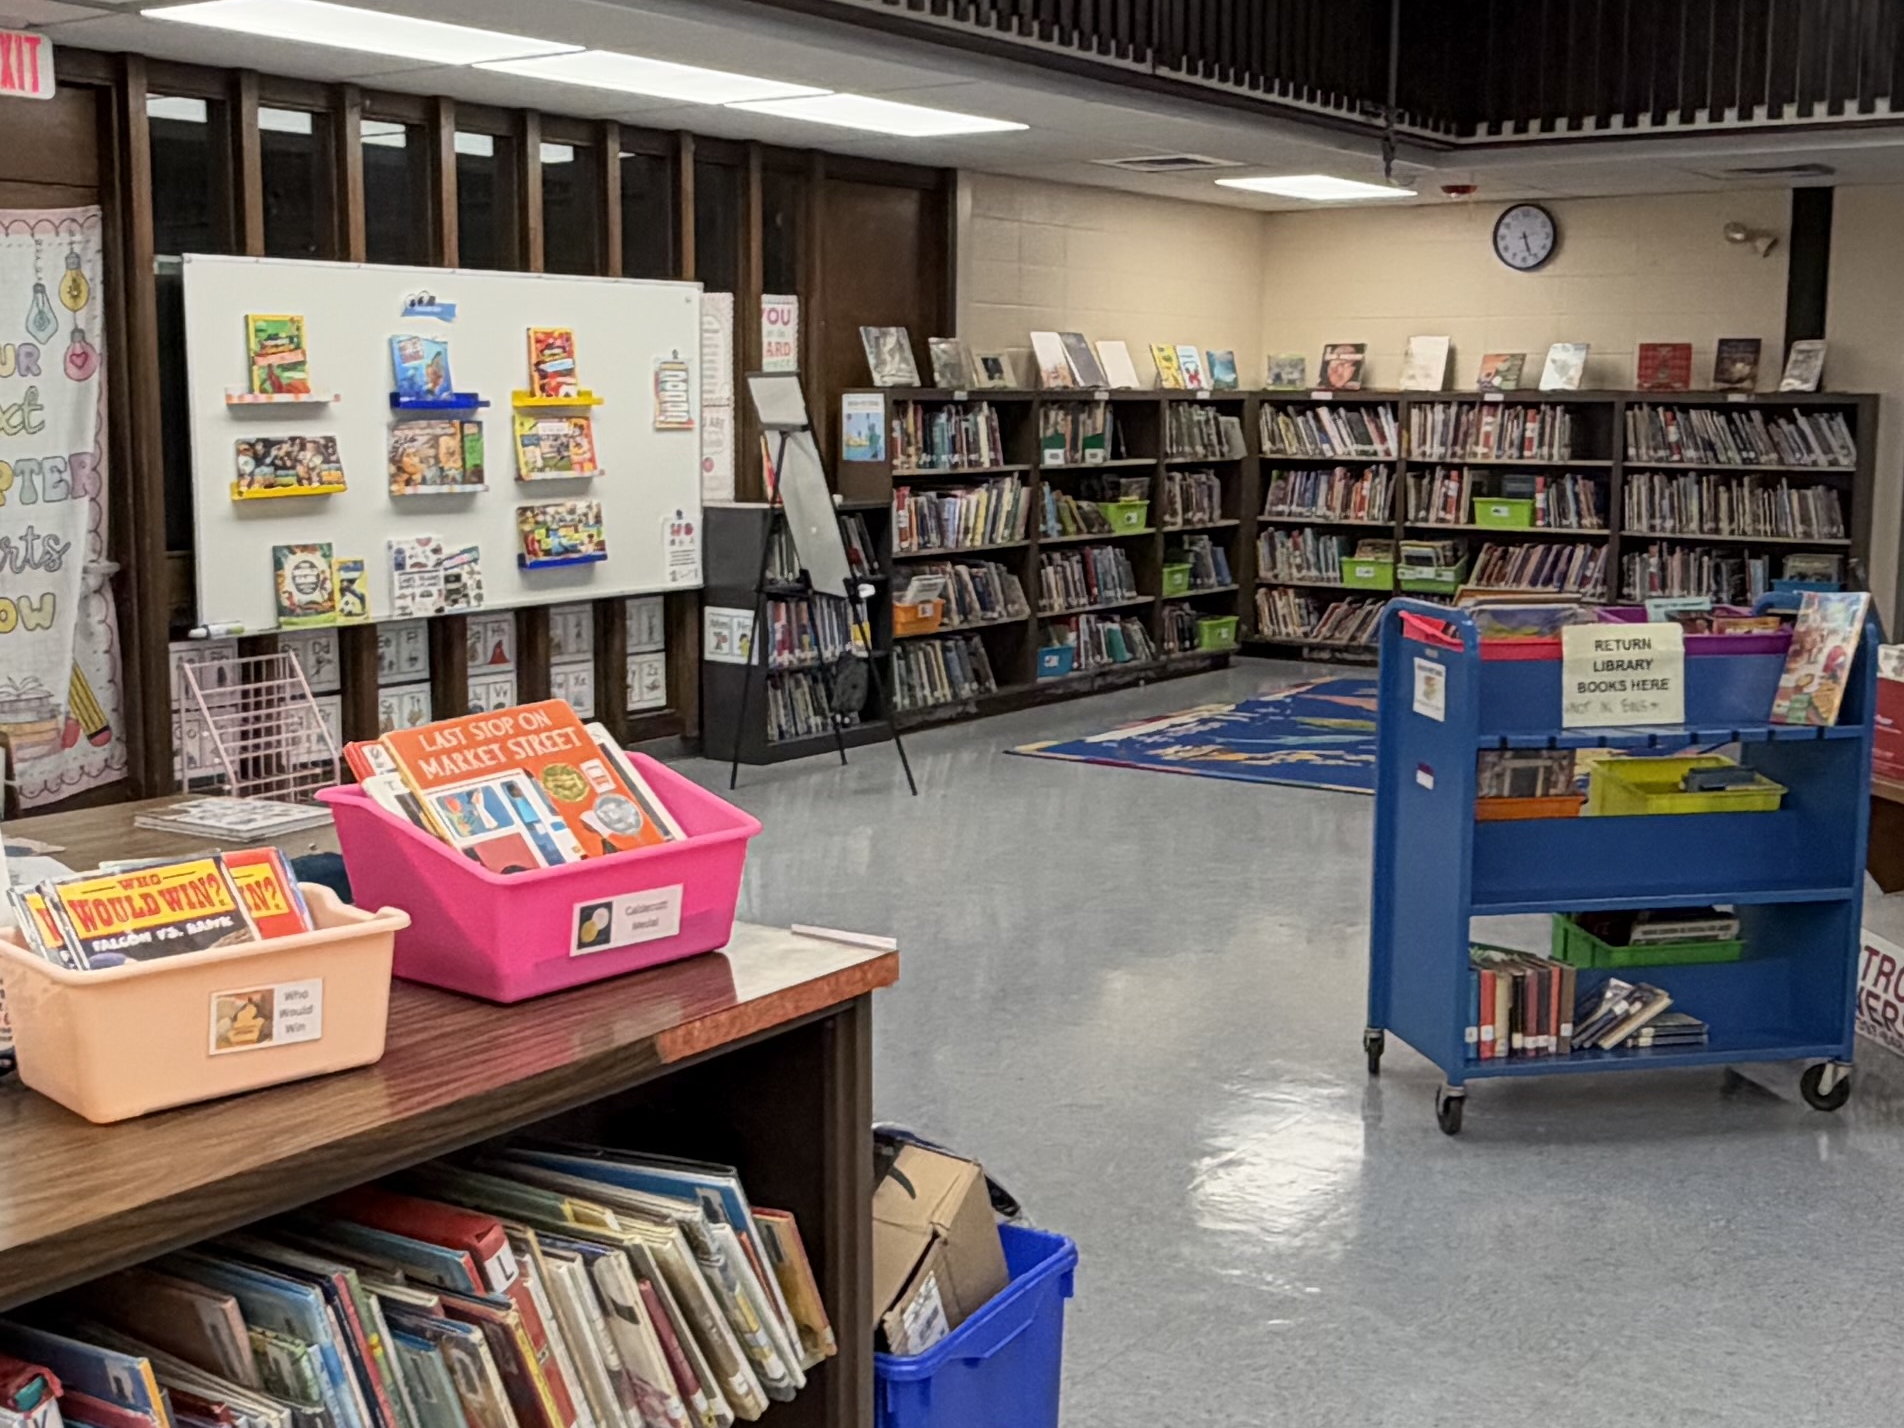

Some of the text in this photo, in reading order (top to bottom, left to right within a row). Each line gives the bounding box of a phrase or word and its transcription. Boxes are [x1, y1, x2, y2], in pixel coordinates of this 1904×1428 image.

[765, 341, 792, 358] ARD
[1594, 638, 1652, 652] RETURN
[1593, 658, 1654, 673] LIBRARY
[1577, 678, 1671, 693] BOOKS HERE
[418, 708, 553, 753] LAST STOP ON
[418, 726, 583, 780] MARKET STREET
[116, 873, 163, 891] WHO
[68, 889, 158, 933] WOULD
[157, 872, 224, 919] WIN?
[237, 875, 282, 914] IN?
[92, 926, 153, 954] FALCON
[155, 920, 184, 942] VS.
[282, 988, 310, 1003] Who
[278, 1003, 314, 1020] Would
[285, 1019, 308, 1035] Win
[497, 1255, 517, 1285] L
